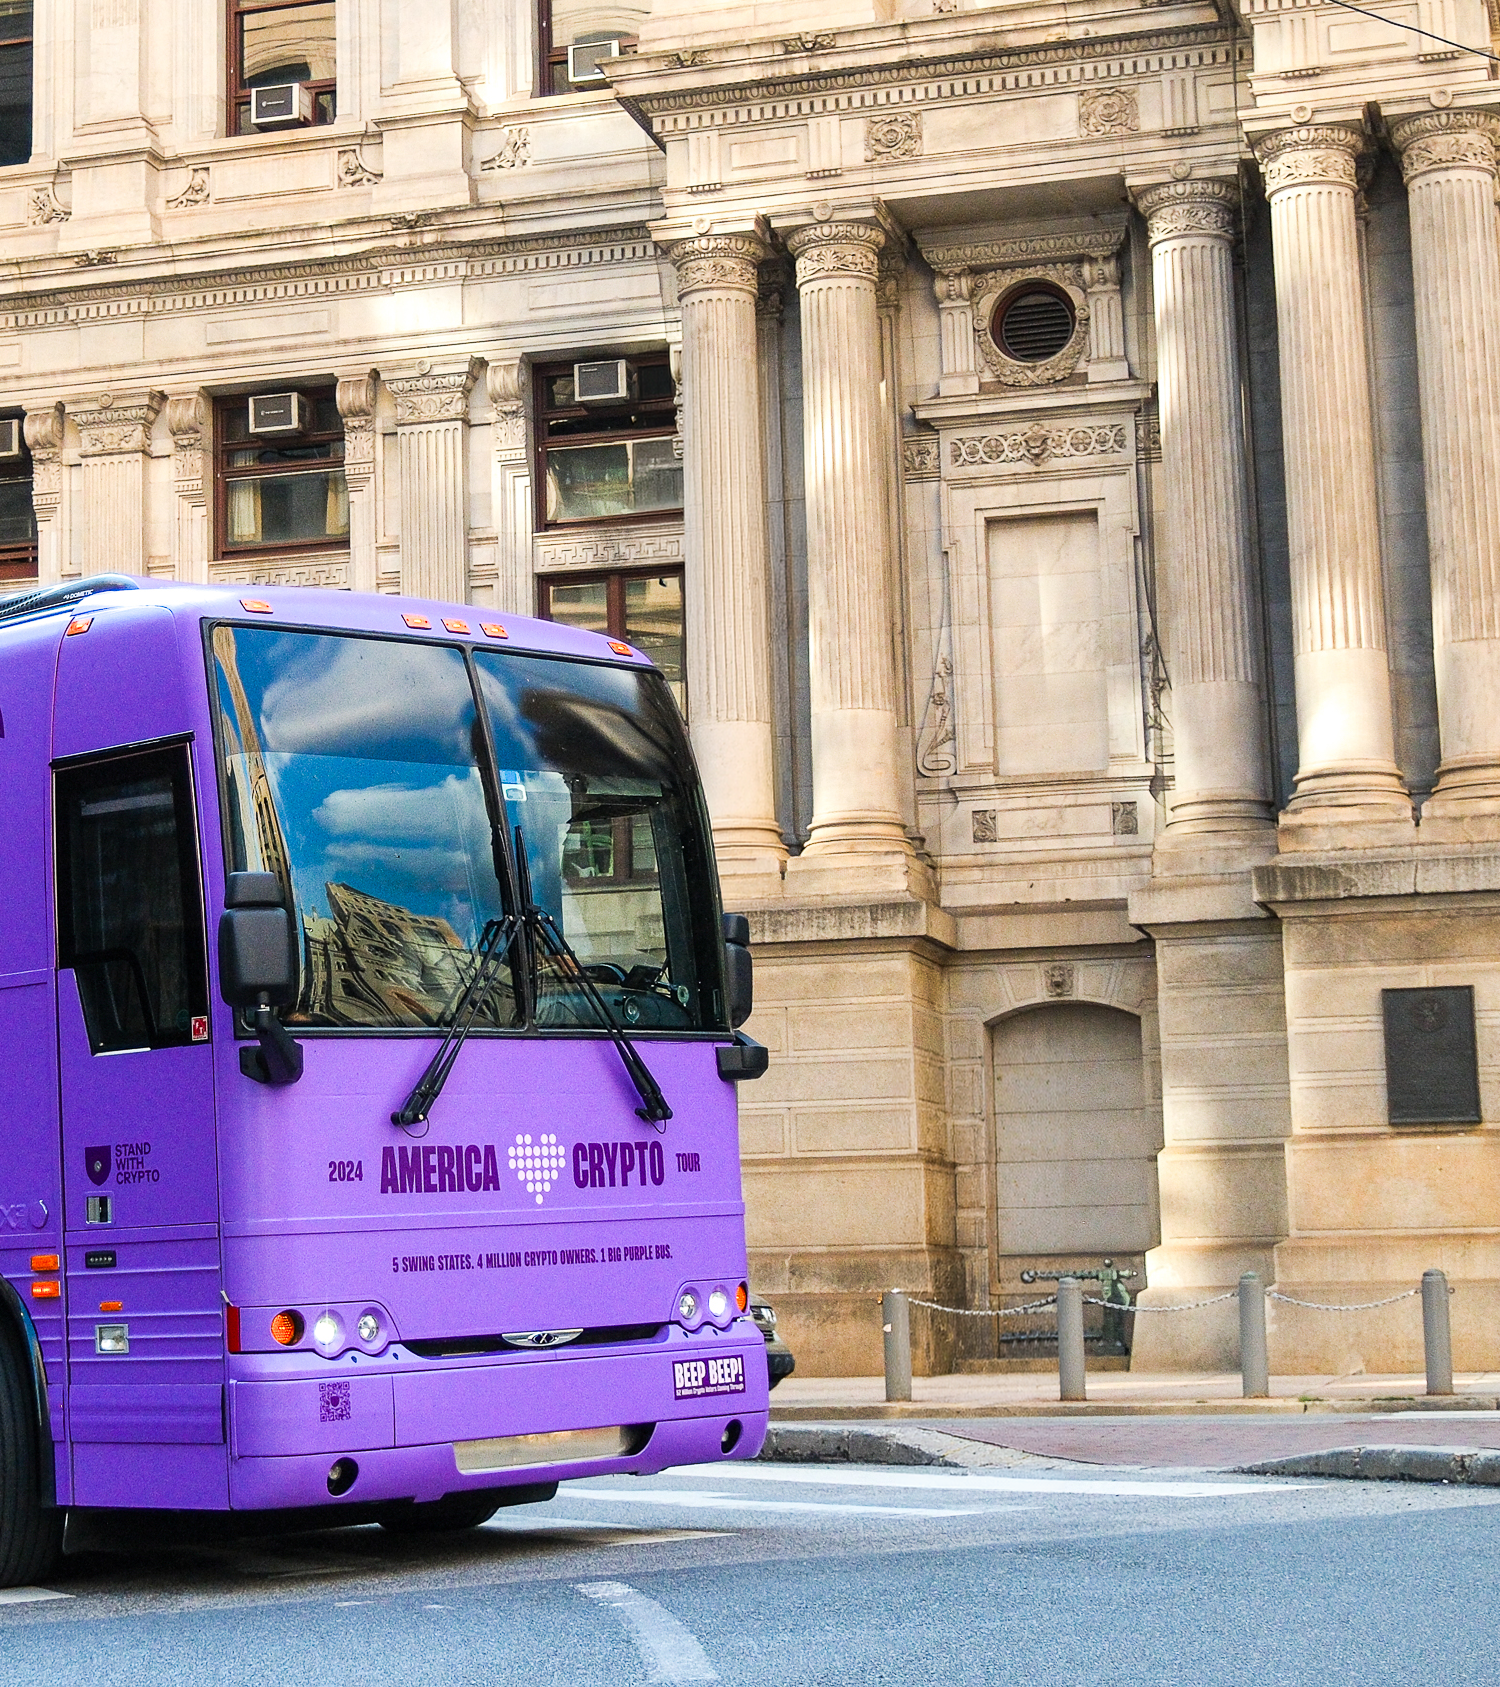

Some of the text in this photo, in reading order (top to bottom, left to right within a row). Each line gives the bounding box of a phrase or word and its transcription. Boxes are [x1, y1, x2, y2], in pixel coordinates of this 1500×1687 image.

[115, 1142, 151, 1157] STAND
[115, 1157, 144, 1171] WITH
[328, 1140, 701, 1194] 2024 AMERICA CRYPTO TOUR
[116, 1169, 160, 1185] CRYPTO
[392, 1244, 673, 1273] 5 SWING STATES. 4 MILLION CRYPTO OWNERS. 1 BIG PURPLE BUS.
[674, 1357, 743, 1388] BEEP BEEP!
